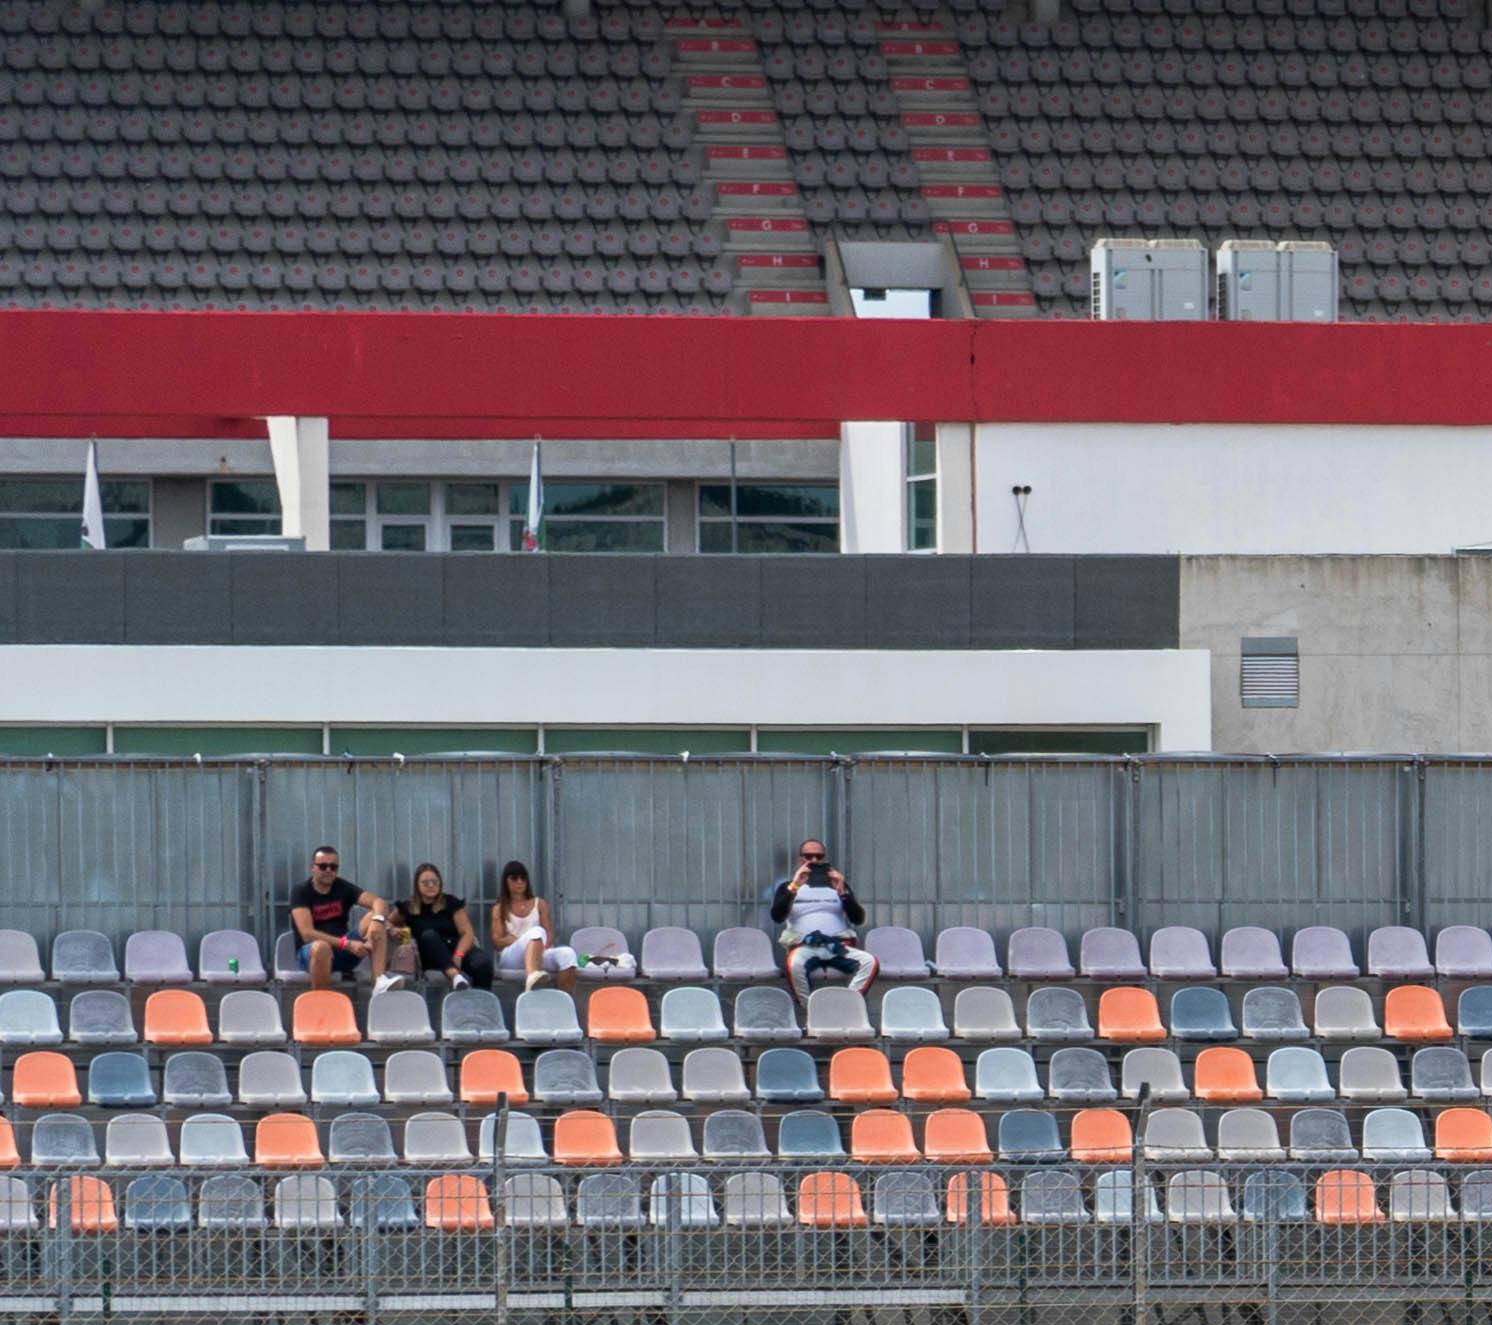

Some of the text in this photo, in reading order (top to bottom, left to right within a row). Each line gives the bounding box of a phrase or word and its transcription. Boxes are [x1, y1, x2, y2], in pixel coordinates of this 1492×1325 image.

[721, 76, 731, 88] C
[731, 112, 741, 123] D
[753, 183, 760, 194] F
[957, 186, 965, 196] F
[761, 220, 772, 231] G
[772, 256, 782, 266] H
[979, 258, 989, 269] H
